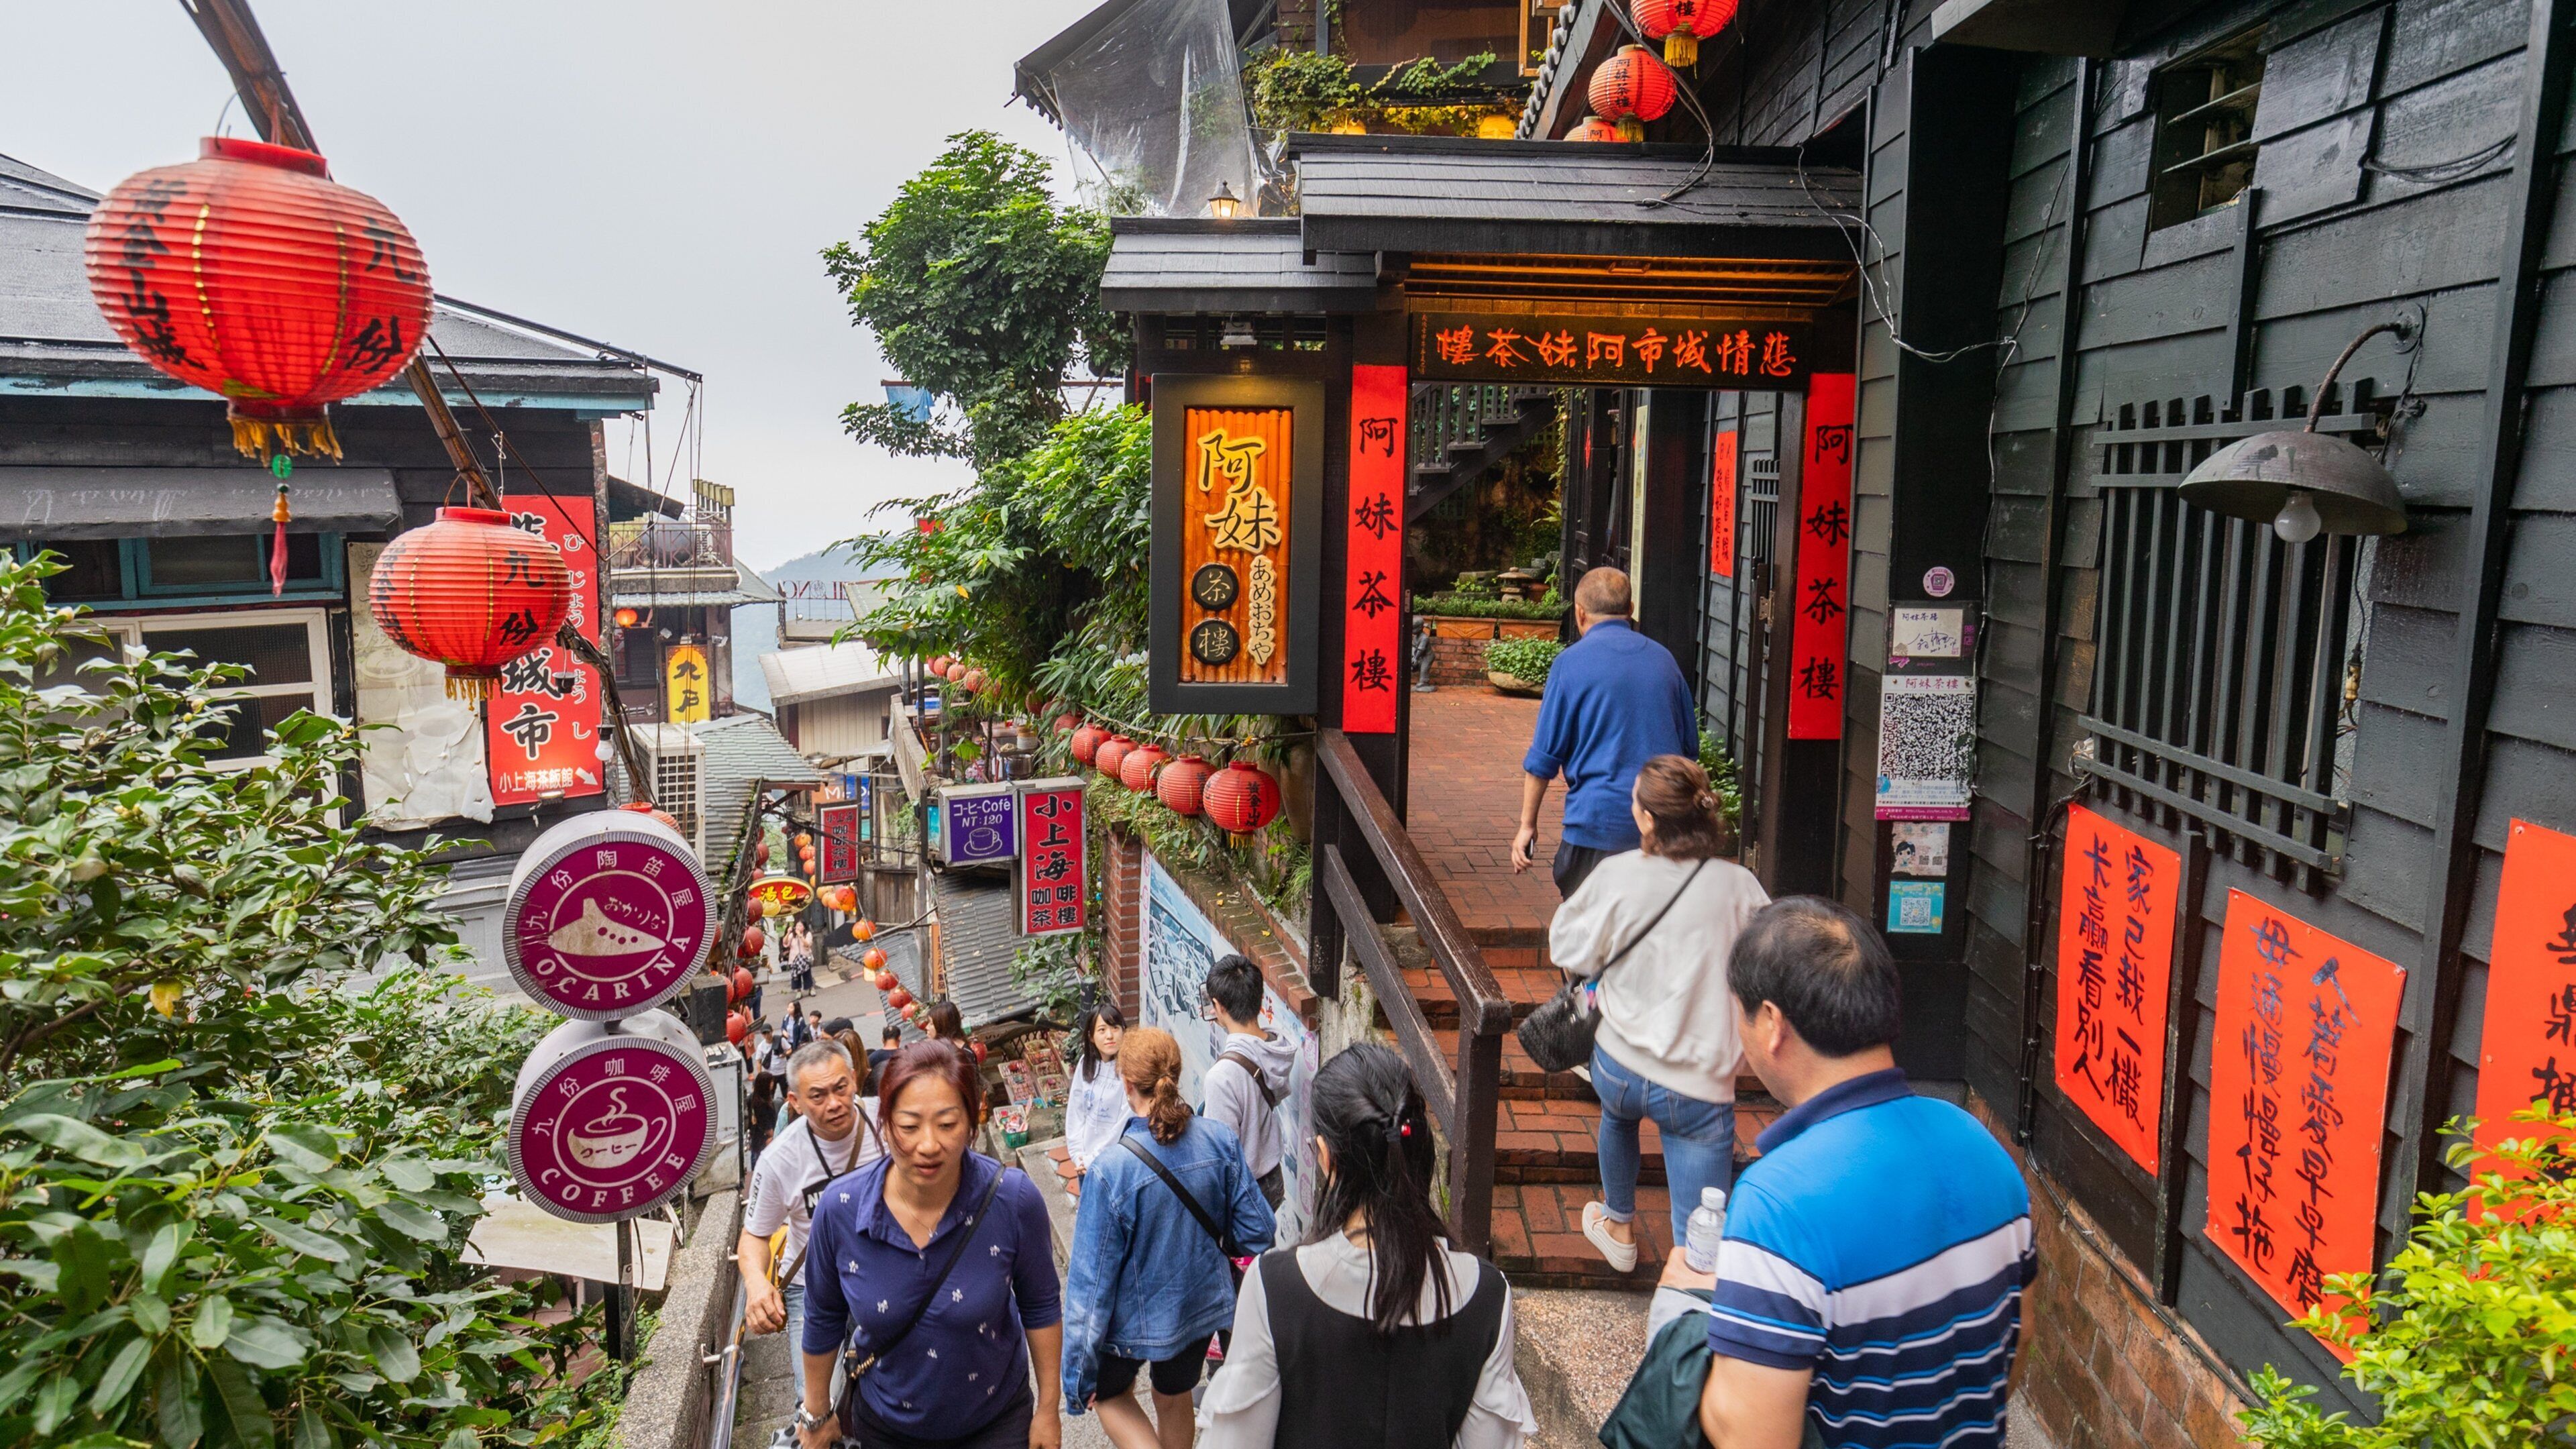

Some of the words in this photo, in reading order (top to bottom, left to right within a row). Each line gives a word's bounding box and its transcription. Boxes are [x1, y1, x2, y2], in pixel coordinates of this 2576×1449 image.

[1615, 58, 1631, 107] 阿妹茶樓
[343, 216, 418, 375] 九份
[1435, 325, 1796, 377] 悲情城市阿妹茶樓
[1201, 431, 1279, 551] 阿妹
[1350, 417, 1399, 692] 阿妹茶樓
[1798, 424, 1854, 700] 阿妹茶樓
[498, 549, 547, 647] 九份
[1198, 570, 1232, 658] 茶樓
[1905, 677, 1959, 690] 阿妹茶樓
[1034, 795, 1075, 881] 小上海
[758, 885, 797, 902] 湯包
[536, 936, 691, 1001] OCARINA
[531, 1057, 697, 1137] 九份咖啡屋
[540, 1152, 686, 1208] COFFEE
[580, 1144, 637, 1158] コーヒー
